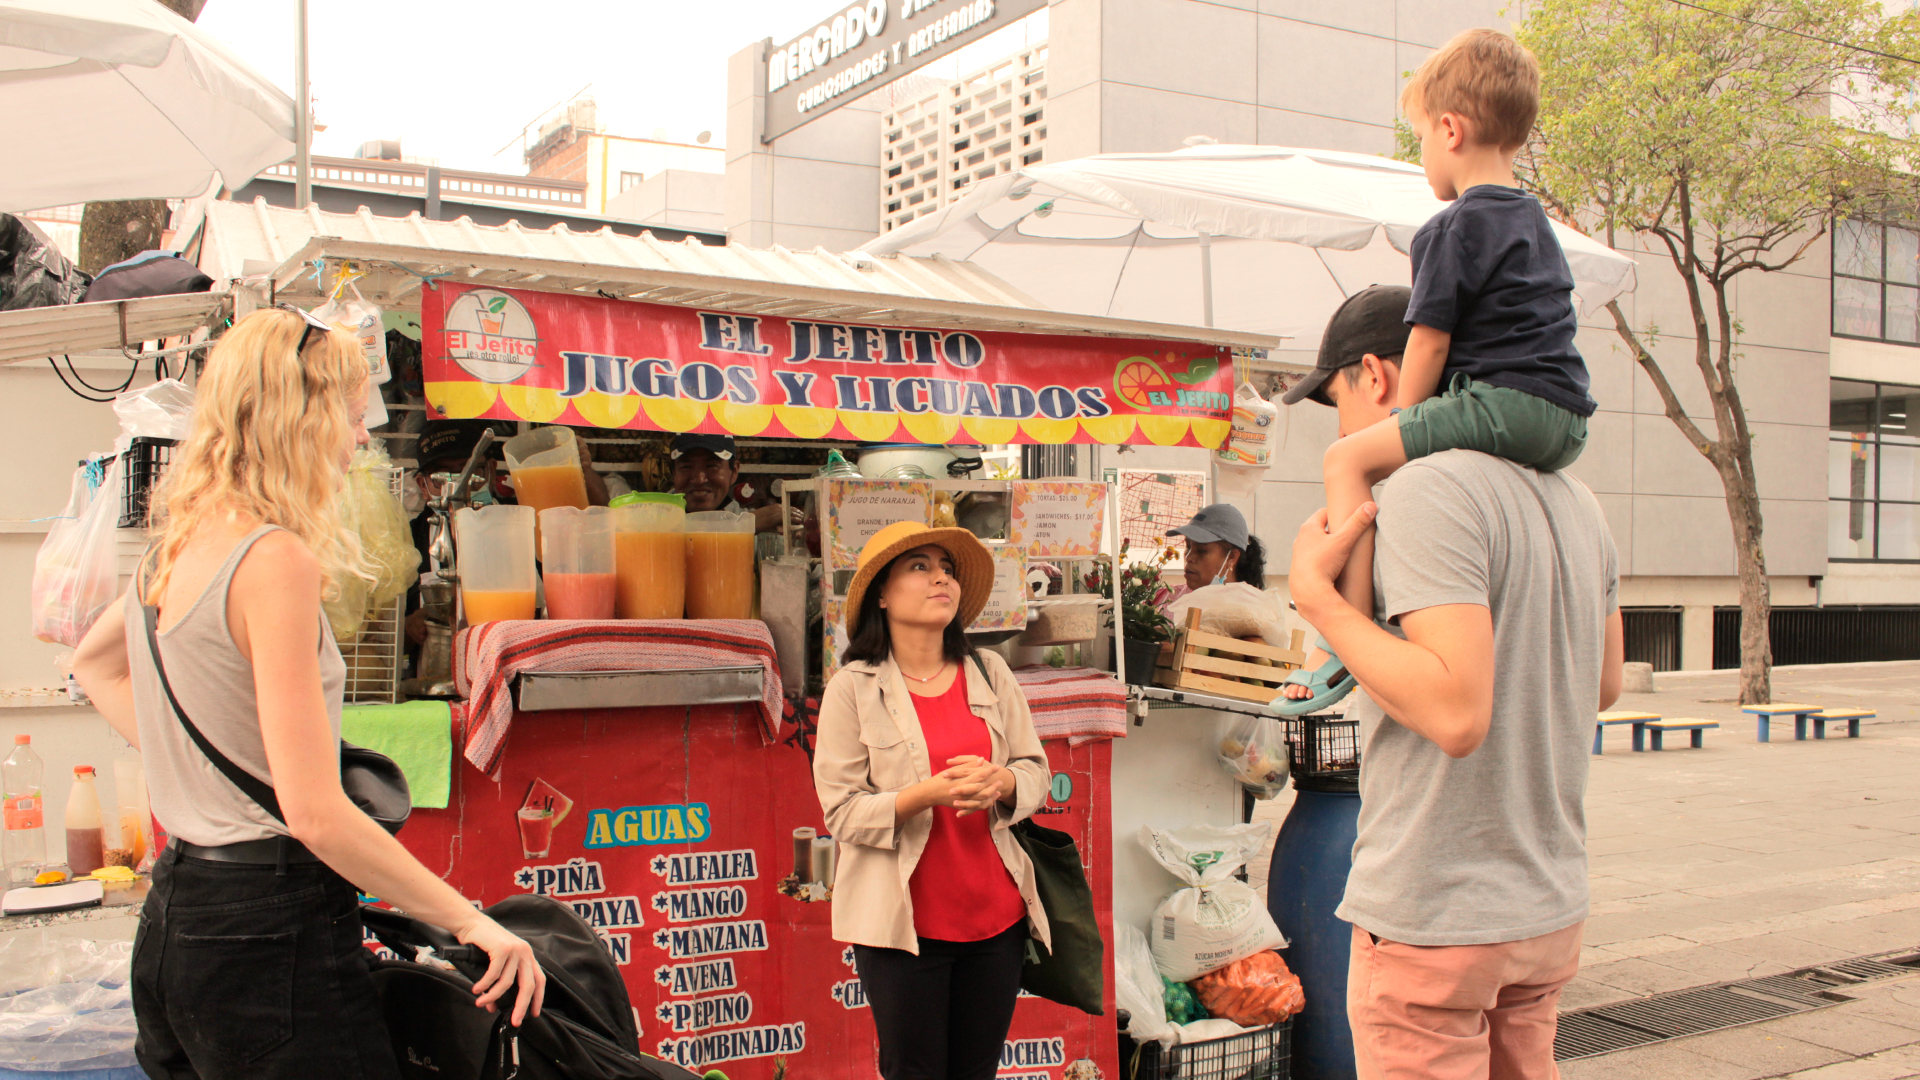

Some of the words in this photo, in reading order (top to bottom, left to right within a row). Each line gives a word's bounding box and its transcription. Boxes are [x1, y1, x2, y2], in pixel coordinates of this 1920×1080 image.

[768, 0, 888, 93] MERCADO
[797, 49, 888, 113] CURIOSIDADES
[892, 41, 905, 64] Y
[909, 0, 995, 57] ARTESANIAS
[446, 331, 468, 349] El
[475, 334, 536, 356] Jefito
[699, 312, 772, 355] EL
[785, 320, 983, 367] JEFITO
[481, 351, 497, 360] otro
[559, 352, 758, 404] JUGOS
[774, 371, 815, 406] Y
[834, 375, 1109, 416] LICUADOS
[1148, 391, 1173, 406] EL
[1175, 388, 1230, 411] JEFITO
[848, 496, 868, 504] JUGO
[869, 496, 880, 504] DE
[1075, 513, 1094, 521] $17.00
[589, 805, 706, 845] AGUAS
[1034, 806, 1064, 815] OLLO
[535, 860, 602, 894] PIÑA
[669, 852, 756, 883] ALFALFA
[573, 899, 641, 927] PAYA
[670, 888, 744, 919] MANGO
[671, 922, 766, 957] MANZANA
[1194, 951, 1214, 961] AZÚCAR
[1215, 948, 1234, 959] MORENA
[673, 961, 734, 992] AVENA
[674, 995, 750, 1030] PEPINO
[673, 1025, 804, 1066] COMBINADAS
[1000, 1040, 1062, 1067] OCHAS
